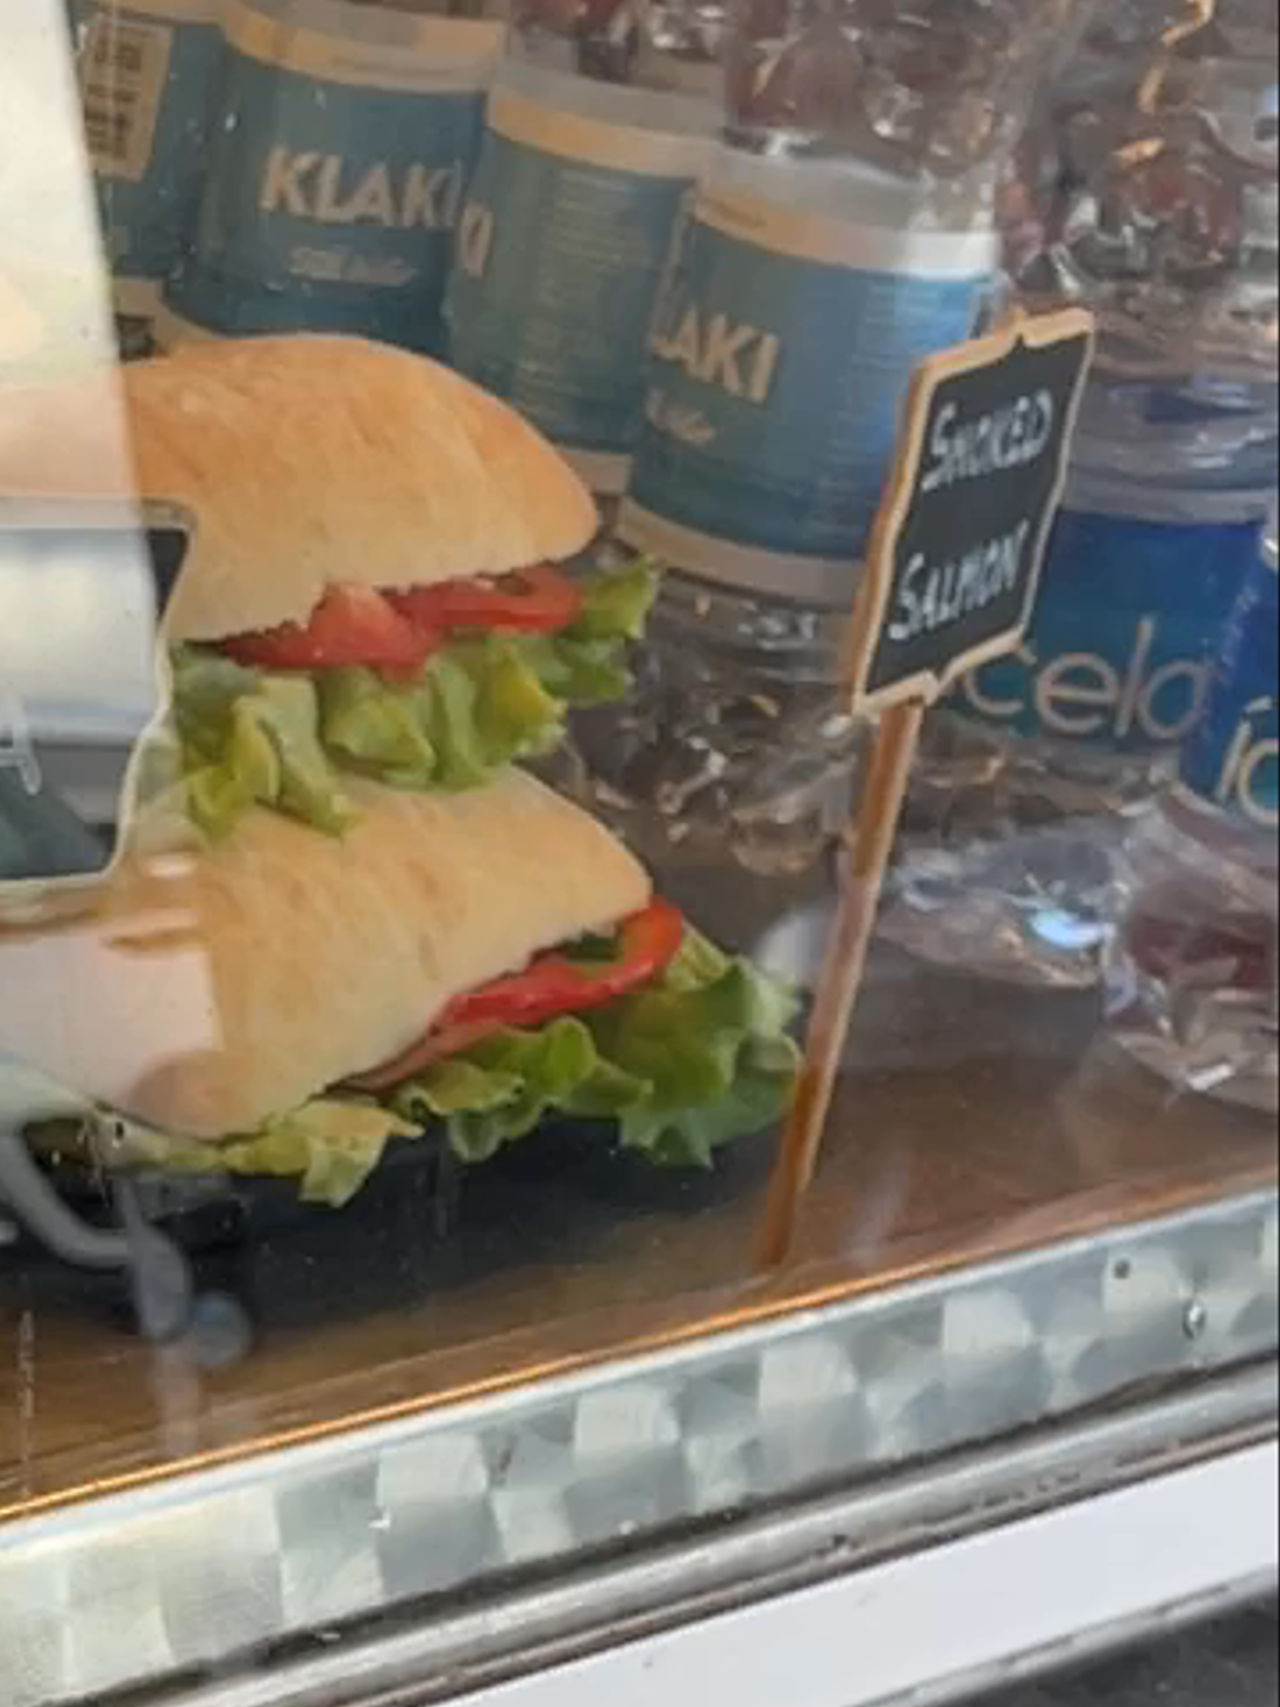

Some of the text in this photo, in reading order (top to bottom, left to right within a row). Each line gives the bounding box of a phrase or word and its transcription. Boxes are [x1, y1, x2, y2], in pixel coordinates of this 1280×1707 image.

[257, 143, 464, 229] KLAKI
[922, 389, 1053, 491] SMOKED
[888, 518, 1031, 640] SALMON
